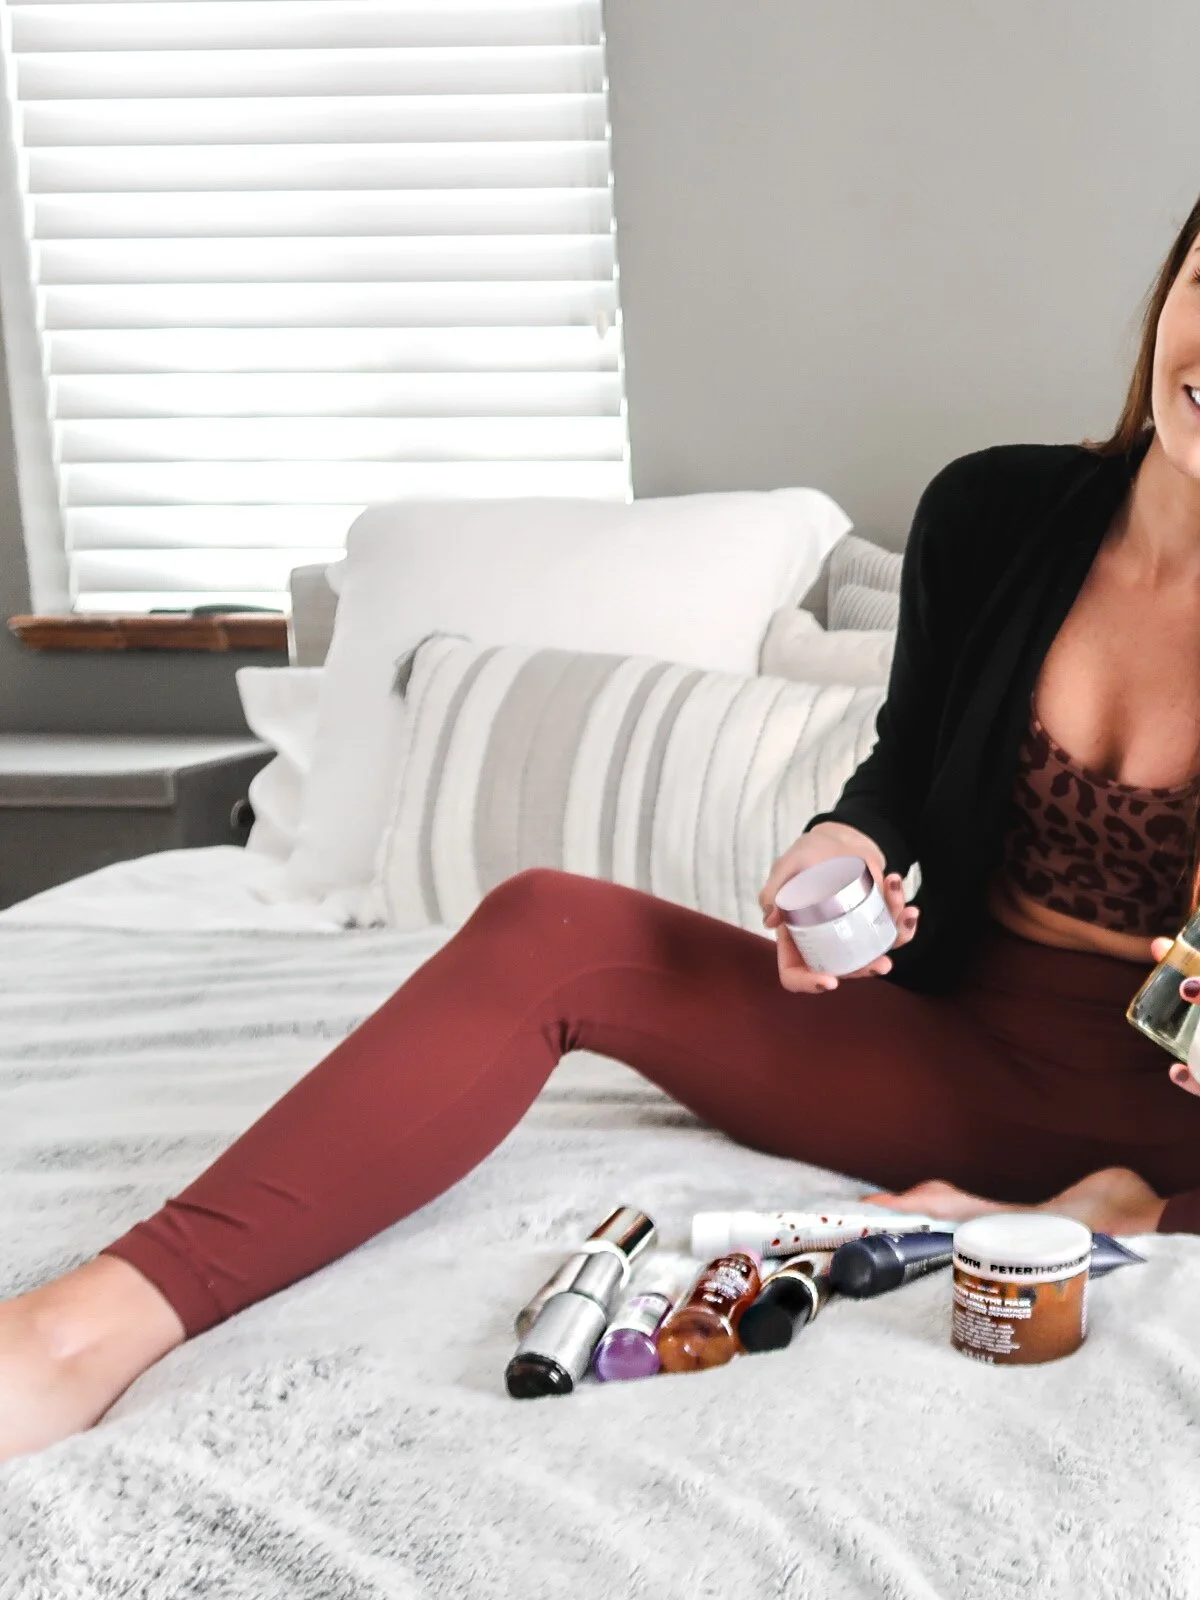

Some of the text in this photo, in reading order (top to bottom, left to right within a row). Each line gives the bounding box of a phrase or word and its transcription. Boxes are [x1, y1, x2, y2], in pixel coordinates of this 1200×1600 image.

[957, 1253, 981, 1269] ROTH
[969, 1293, 1003, 1306] ENZYME
[1004, 1298, 1032, 1308] MASK
